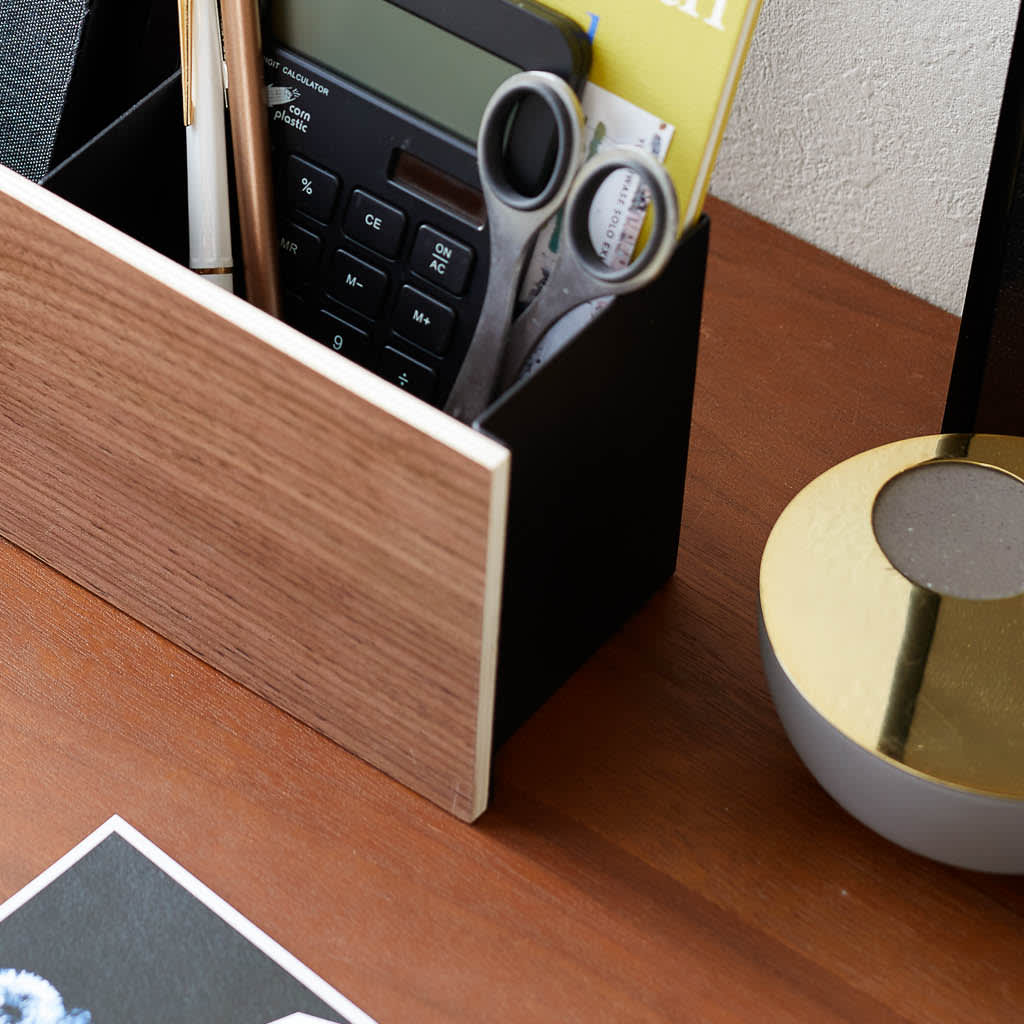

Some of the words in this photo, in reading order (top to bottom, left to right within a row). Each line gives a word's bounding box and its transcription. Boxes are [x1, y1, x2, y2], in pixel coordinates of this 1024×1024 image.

[264, 56, 280, 69] IGIT
[282, 66, 329, 96] CALCULATOR
[273, 109, 308, 133] plastic
[289, 105, 311, 122] corn
[301, 177, 313, 195] %
[364, 214, 382, 230] CE
[280, 237, 298, 254] MR
[435, 243, 452, 259] ON
[429, 260, 446, 275] AC
[412, 309, 431, 326] M+
[332, 335, 343, 351] 9
